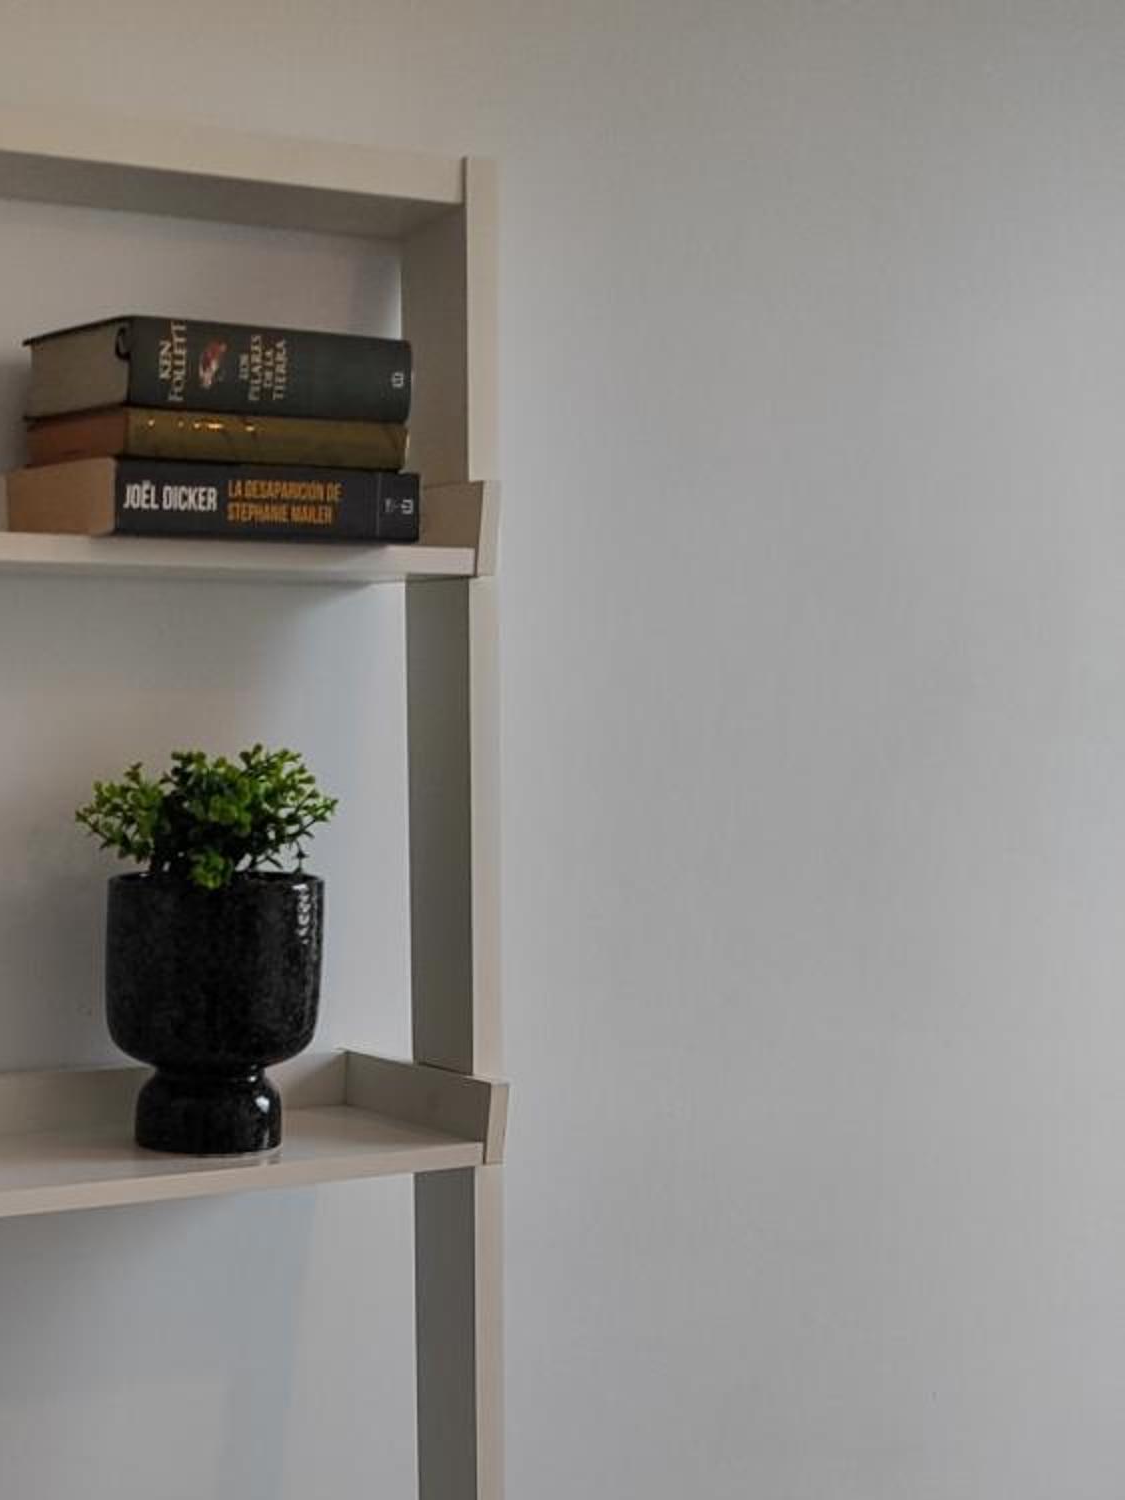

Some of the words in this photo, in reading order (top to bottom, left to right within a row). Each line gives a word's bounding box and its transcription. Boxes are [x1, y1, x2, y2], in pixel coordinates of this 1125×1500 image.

[158, 340, 173, 380] KEN
[168, 321, 187, 402] FOLLETT
[249, 335, 262, 402] PILARES
[263, 349, 274, 367] LA
[273, 340, 287, 401] TIERRA
[263, 369, 274, 388] DE
[123, 480, 159, 510] JOËL
[162, 485, 218, 512] DICKER
[227, 480, 242, 498] LA
[244, 479, 323, 501] DESAPARICIÓN
[325, 482, 343, 502] DE
[227, 502, 289, 523] STEPHANIE
[291, 505, 332, 525] MAILER
